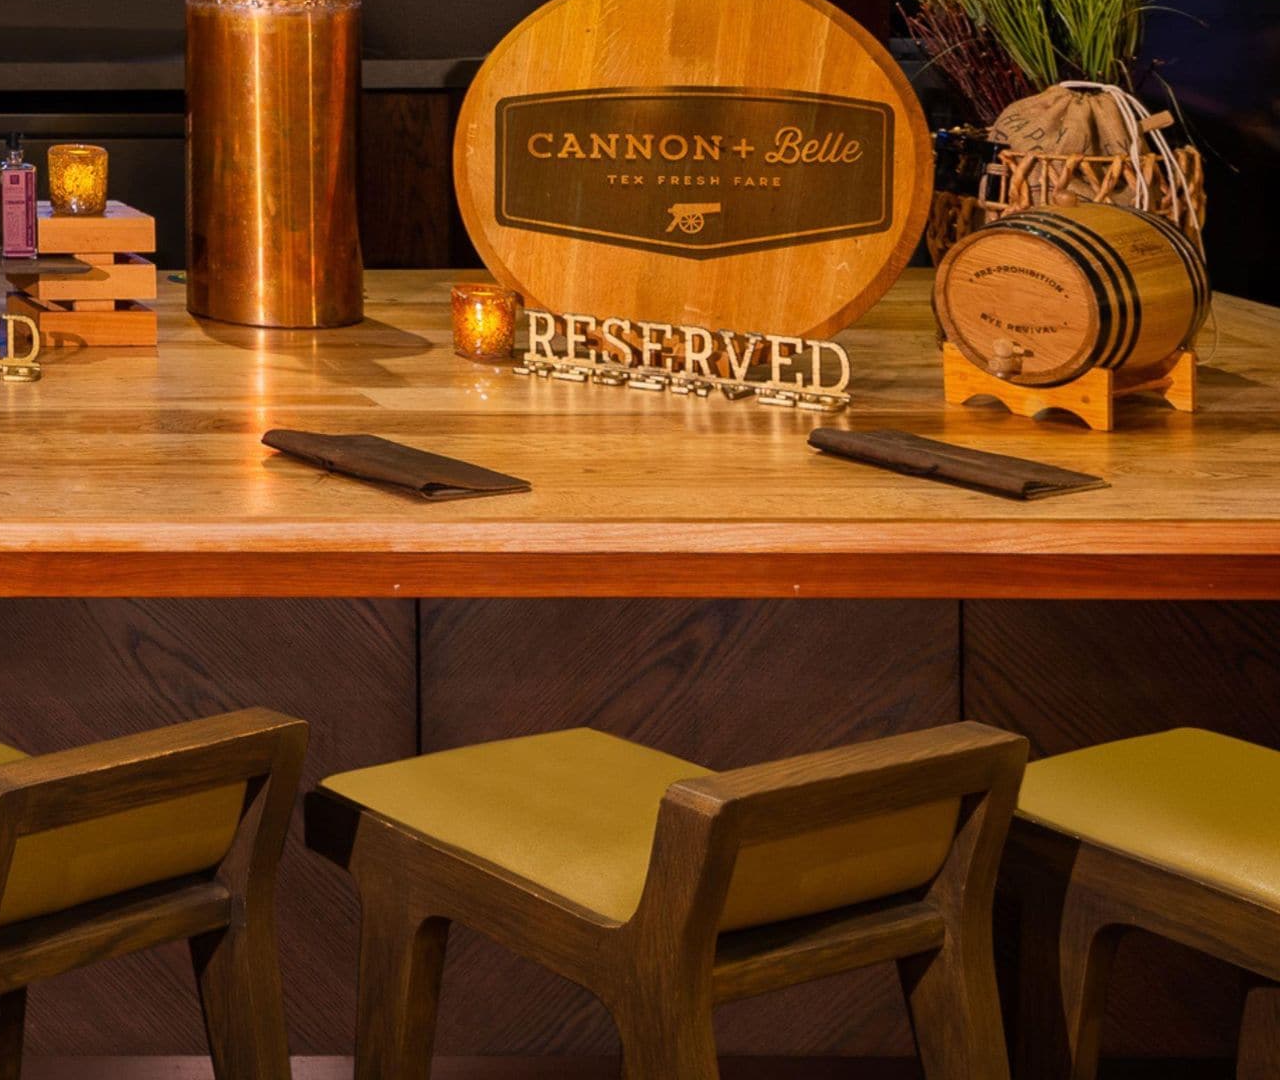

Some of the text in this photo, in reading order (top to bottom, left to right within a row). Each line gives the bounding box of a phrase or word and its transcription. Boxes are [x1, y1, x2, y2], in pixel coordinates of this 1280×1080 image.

[527, 132, 723, 161] CANNON
[765, 126, 864, 165] Belle
[607, 174, 782, 188] TEX FRESH FARE
[974, 265, 1064, 293] PRE-PROHIBITION
[980, 312, 1057, 333] RYE REVIVAL
[523, 308, 852, 398] RESERVED
